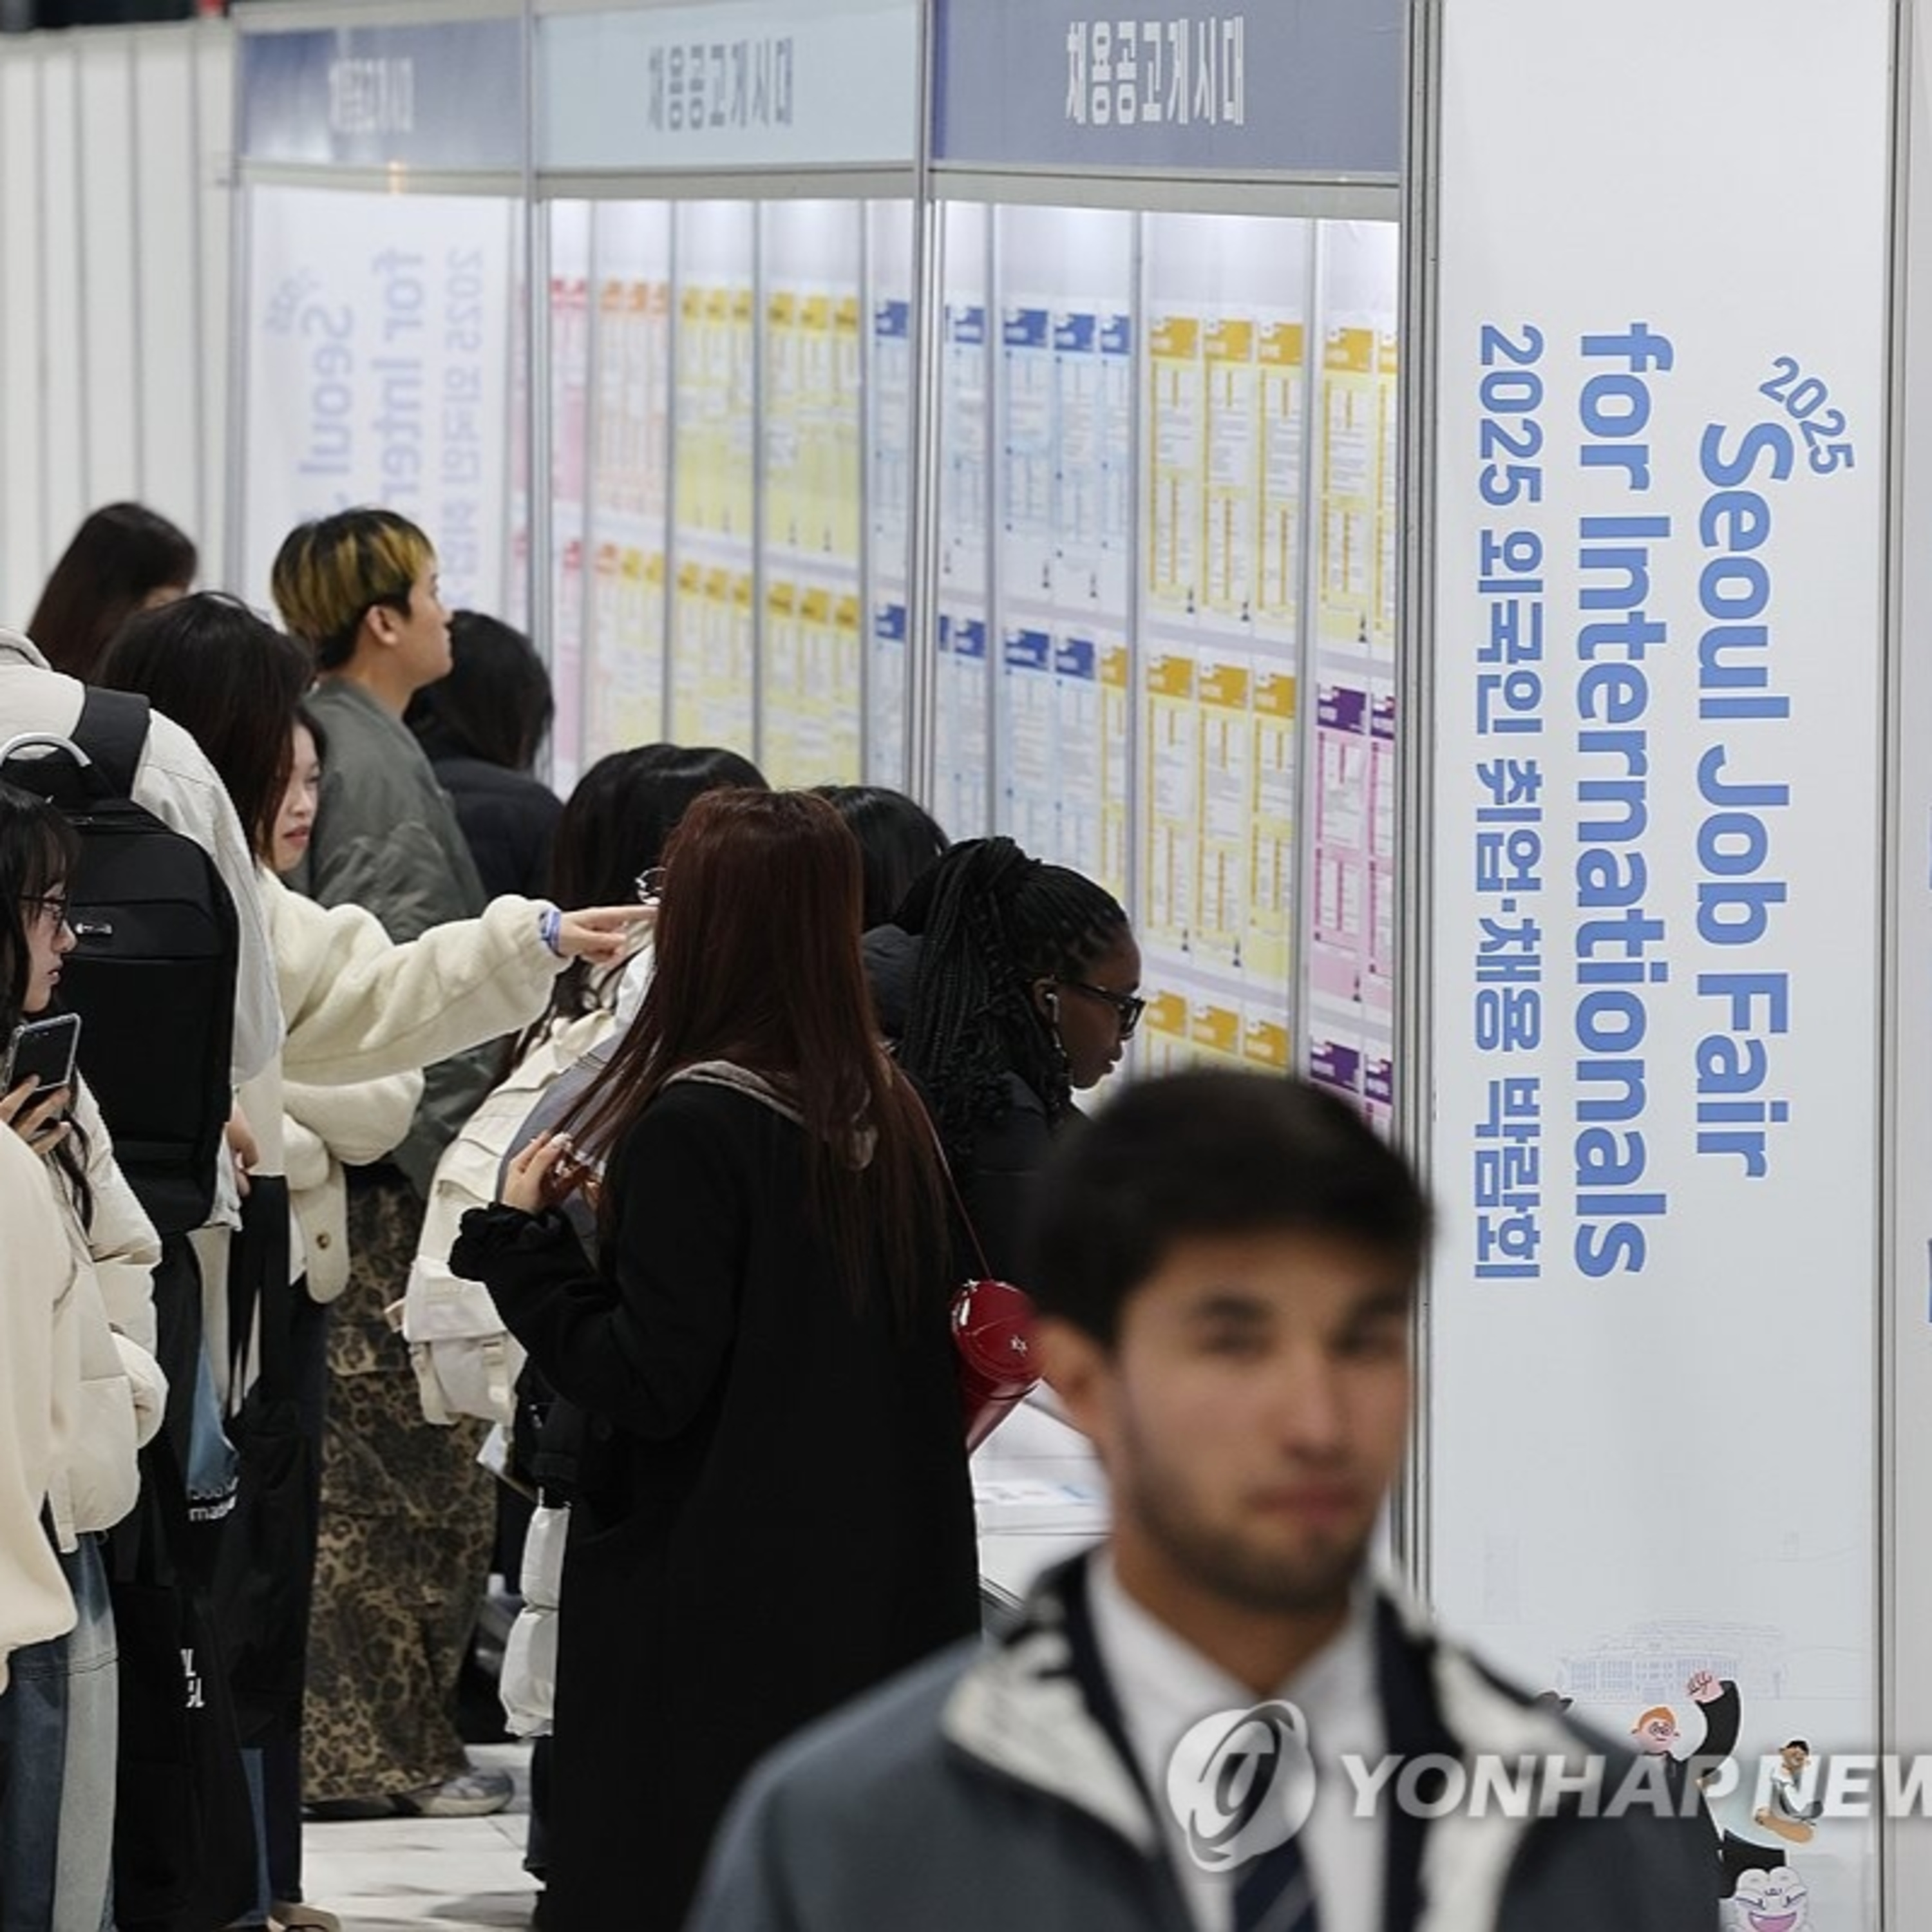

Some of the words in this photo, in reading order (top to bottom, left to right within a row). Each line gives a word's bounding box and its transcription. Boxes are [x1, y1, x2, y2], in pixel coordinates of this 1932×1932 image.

[649, 37, 792, 131] 채용공고게시대
[1066, 17, 1244, 125] 채용공고게시대
[1478, 323, 1545, 507] 2025
[1578, 322, 1674, 492] for
[1759, 357, 1854, 474] 2025
[1477, 528, 1544, 735] 외국인
[1698, 422, 1794, 721] Seoul
[1475, 759, 1543, 1052] 취업·채용
[1574, 515, 1671, 1278] Internationals
[1696, 744, 1790, 946] Job
[1696, 971, 1790, 1179] Fair
[1473, 1076, 1542, 1280] 박람회
